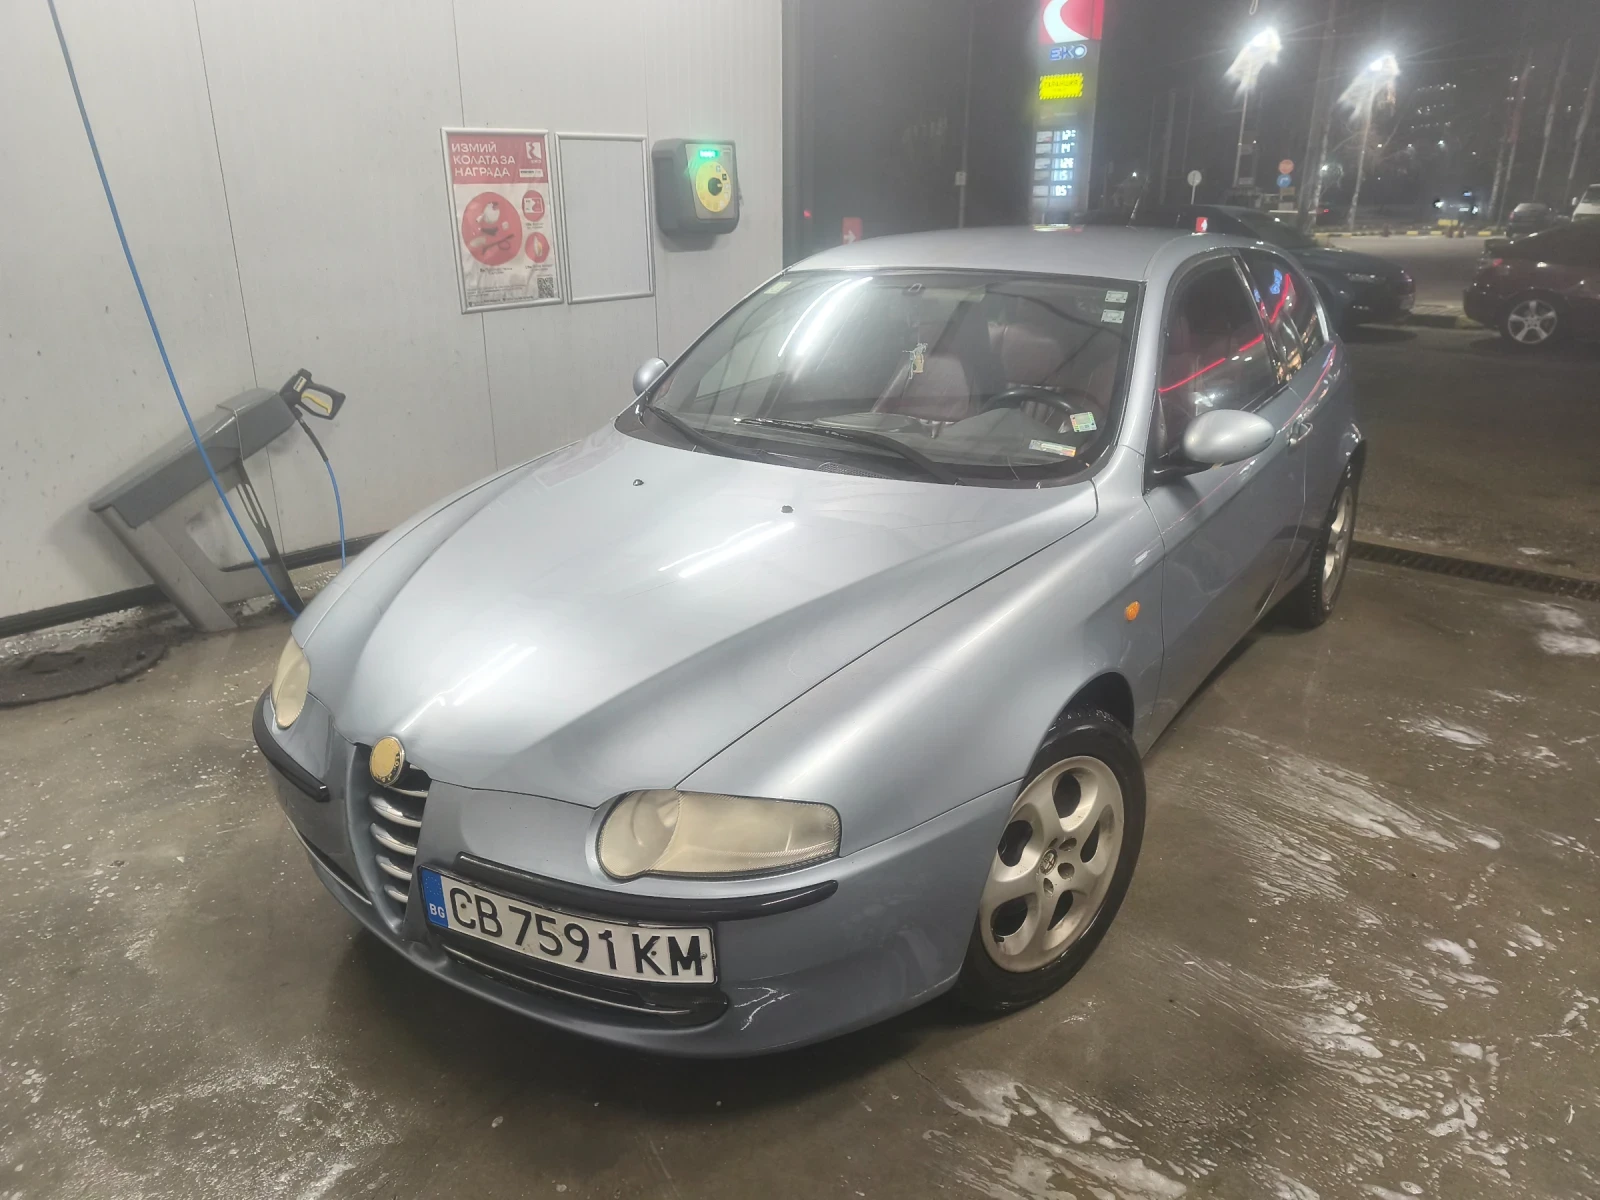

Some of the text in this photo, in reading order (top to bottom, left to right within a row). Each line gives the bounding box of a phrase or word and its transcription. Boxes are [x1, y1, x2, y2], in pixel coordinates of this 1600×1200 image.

[1049, 44, 1088, 61] EKO
[451, 141, 497, 153] ИЗМИЙ
[453, 155, 516, 165] КОЛАТА ЗА
[455, 167, 511, 178] НАГРАДА
[429, 903, 446, 918] BG
[449, 887, 704, 977] CB 7591 KM
